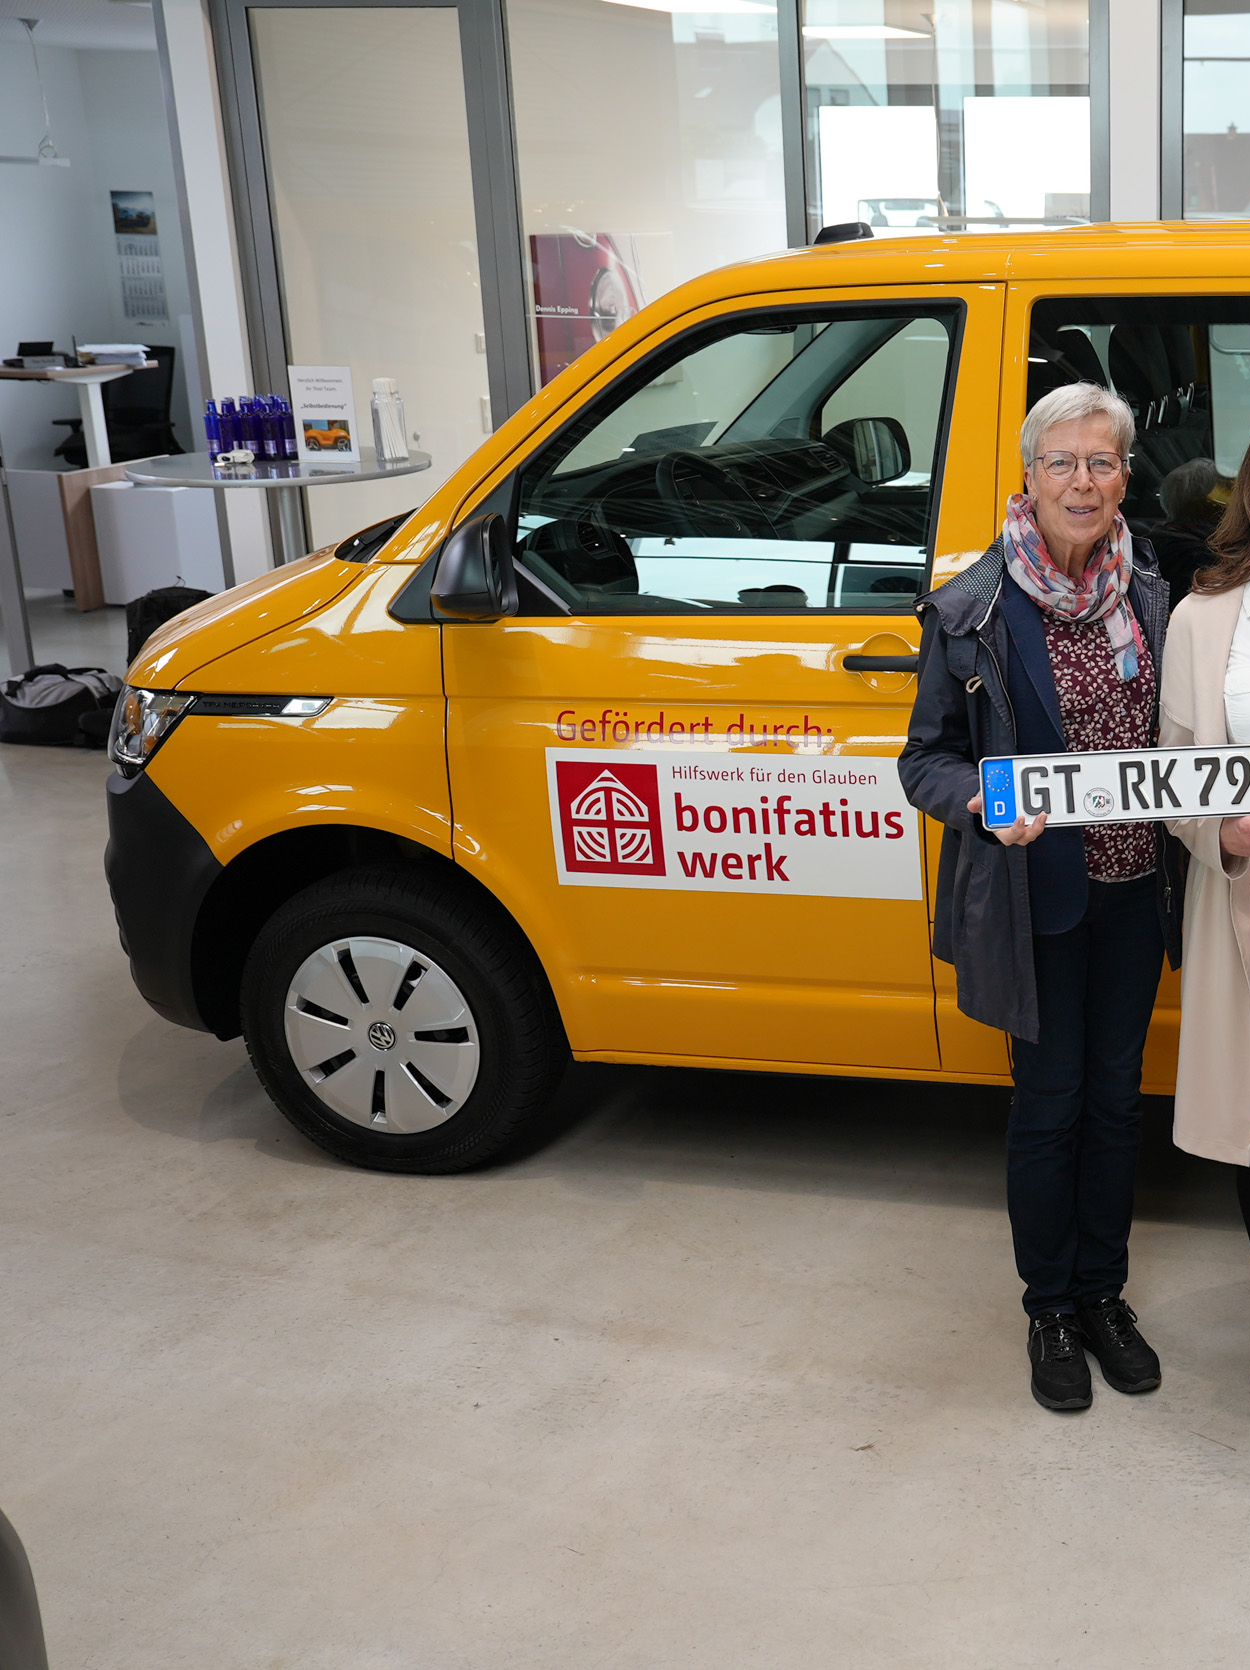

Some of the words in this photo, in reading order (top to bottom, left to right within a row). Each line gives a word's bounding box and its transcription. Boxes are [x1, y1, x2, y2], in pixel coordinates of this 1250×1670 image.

[556, 305, 579, 314] Epping
[556, 709, 713, 745] Gefördert
[726, 713, 833, 748] durch:
[671, 765, 744, 782] Hilfswerk
[750, 767, 772, 782] für
[777, 768, 806, 784] den
[812, 769, 877, 785] Glauben
[1020, 764, 1081, 816] GT
[1118, 758, 1182, 811] RK
[674, 792, 905, 840] bonifatius
[993, 801, 1006, 816] D
[677, 842, 790, 882] werk
